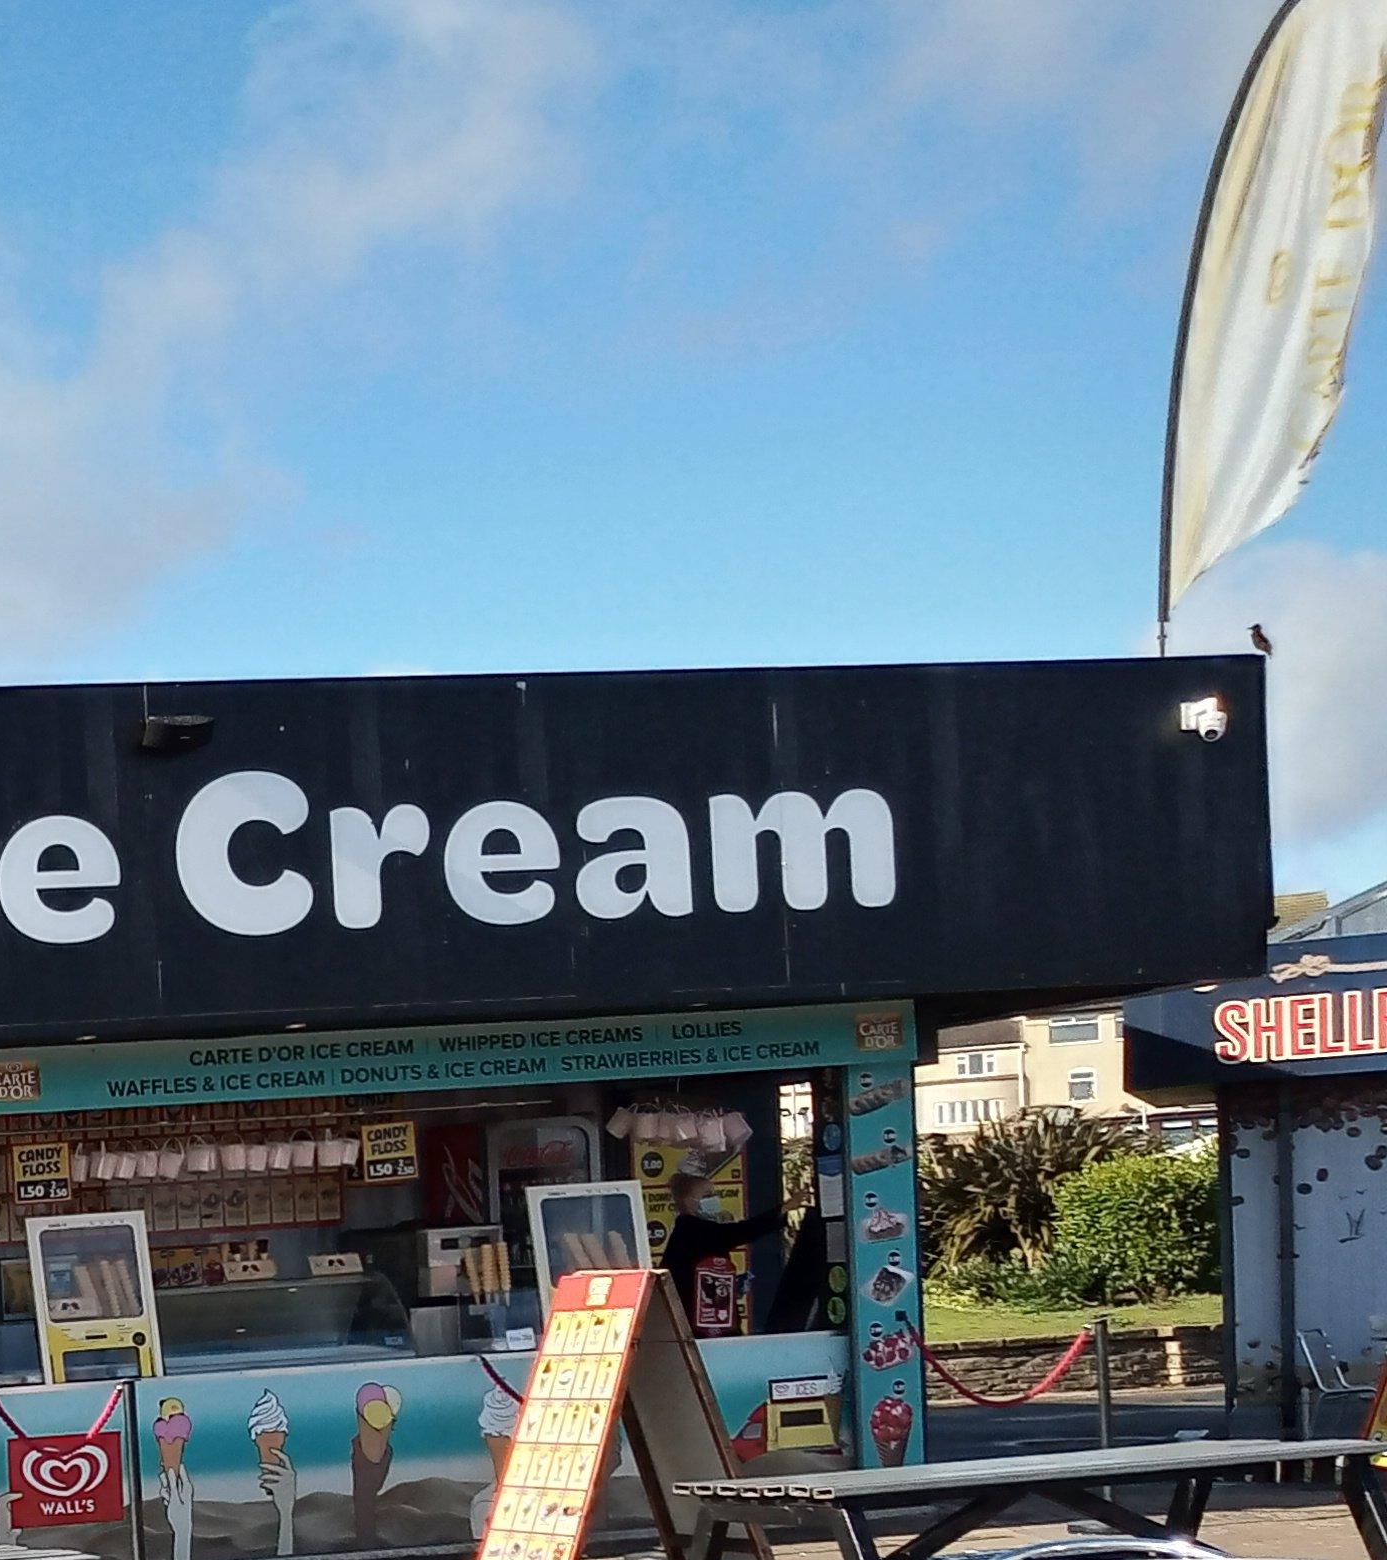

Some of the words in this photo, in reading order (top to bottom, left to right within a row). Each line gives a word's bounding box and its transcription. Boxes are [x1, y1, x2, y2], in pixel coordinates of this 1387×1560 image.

[176, 770, 895, 936] Cream
[189, 1049, 252, 1067] CARTE
[258, 1045, 304, 1064] D'OR
[311, 1043, 340, 1060] ICE
[347, 1039, 414, 1059] CREAM
[439, 1033, 526, 1052] WHIPPED
[531, 1031, 561, 1048] ICE
[567, 1026, 642, 1047] CREAMS
[671, 1021, 742, 1041] LOLLIES
[108, 1076, 197, 1097] WAFFLES
[202, 1077, 217, 1092] &
[220, 1073, 251, 1090] ICE
[257, 1069, 326, 1089] CREAM
[340, 1064, 422, 1085] DONUTS
[427, 1064, 440, 1079] &
[444, 1061, 475, 1078] ICE
[480, 1057, 547, 1077] CREAM
[561, 1048, 702, 1073] STRAWBERRIES
[707, 1047, 719, 1063] &
[724, 1045, 752, 1063] ICE
[756, 1040, 821, 1060] CREAM
[367, 1124, 408, 1141] CANDY
[17, 1147, 62, 1163] CANDY
[371, 1139, 406, 1155] FLOSS
[22, 1160, 60, 1176] FLOSS
[40, 1498, 95, 1517] WALL'S
